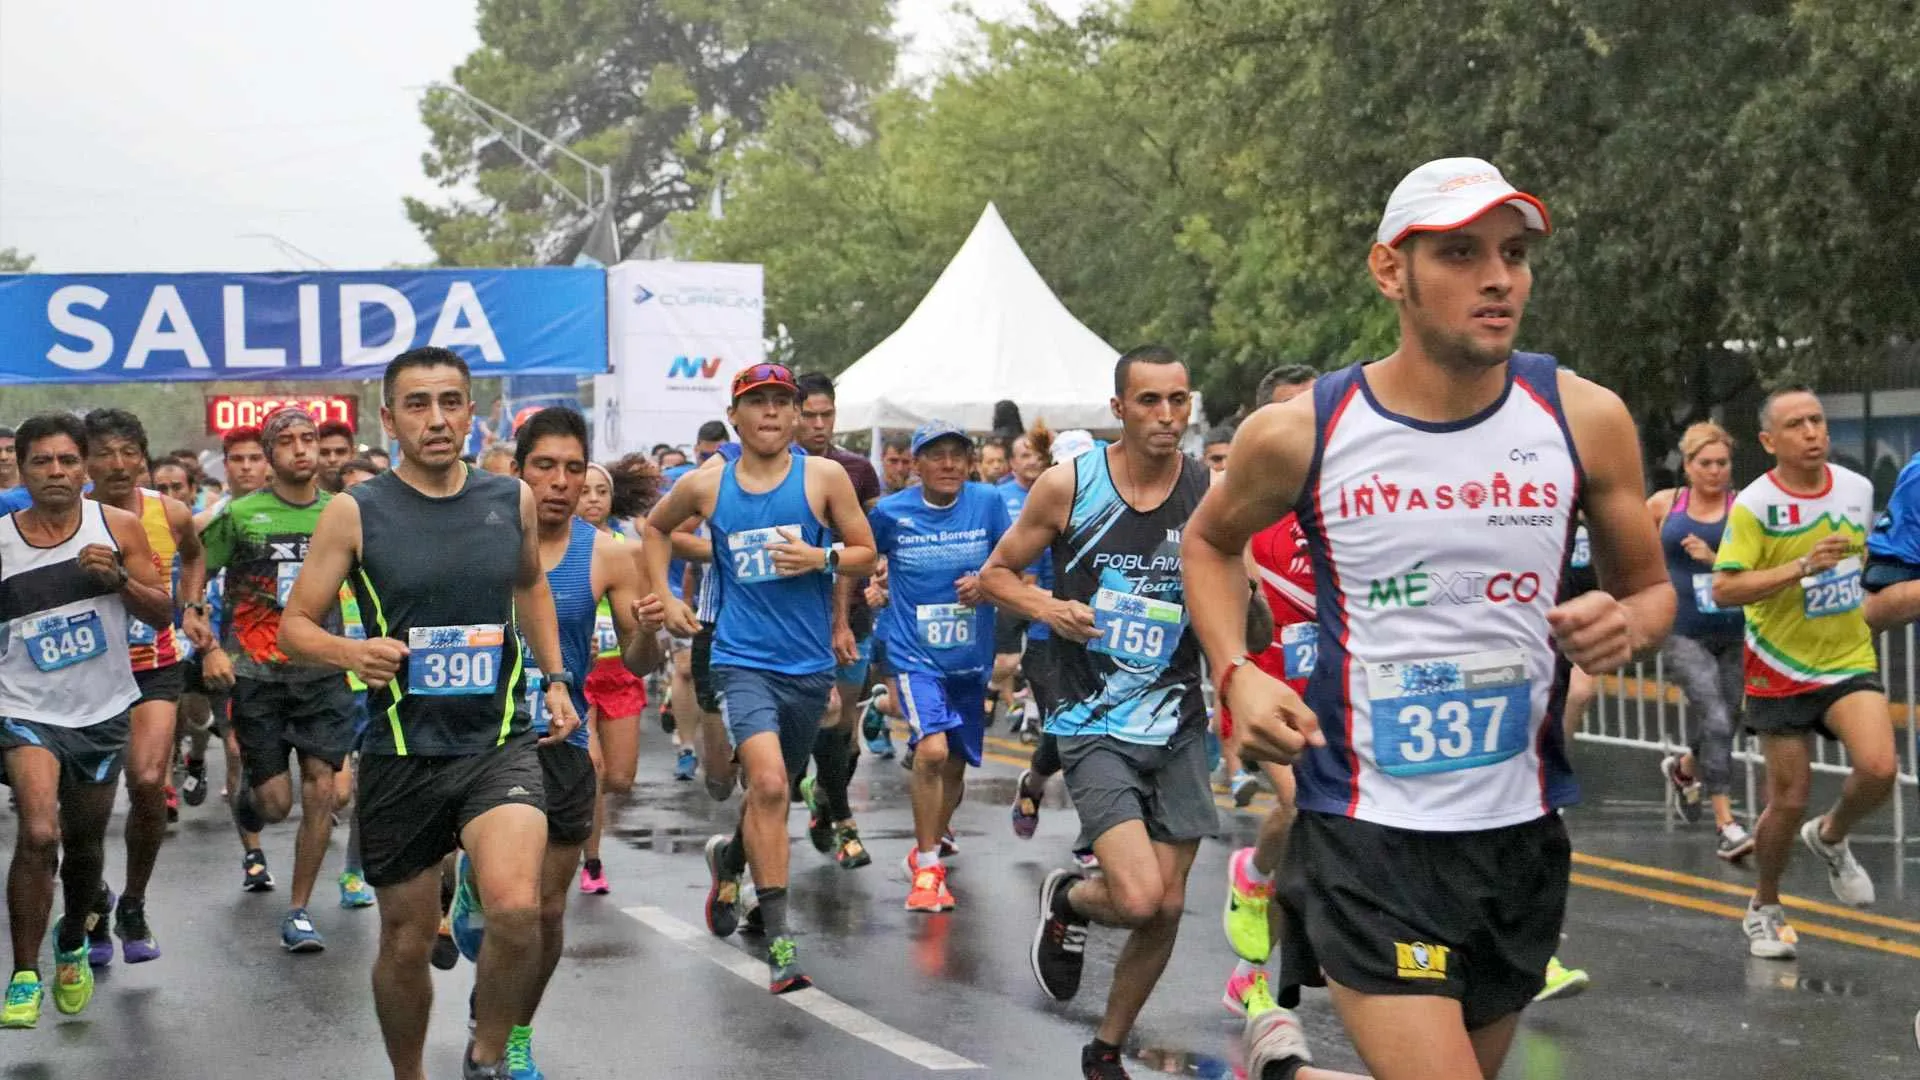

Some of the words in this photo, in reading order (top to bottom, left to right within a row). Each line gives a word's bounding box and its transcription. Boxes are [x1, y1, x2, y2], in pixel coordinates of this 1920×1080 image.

[46, 281, 505, 371] SALIDA
[897, 533, 938, 545] Carrera
[940, 528, 987, 541] Borregos
[1487, 515, 1554, 527] RUNNERS
[1093, 553, 1183, 571] POBLAN
[1368, 561, 1541, 608] MÉXICO
[39, 626, 96, 664] 849
[927, 620, 969, 644] 876
[1107, 618, 1165, 657] 159
[424, 651, 493, 688] 390
[1398, 696, 1508, 763] 337
